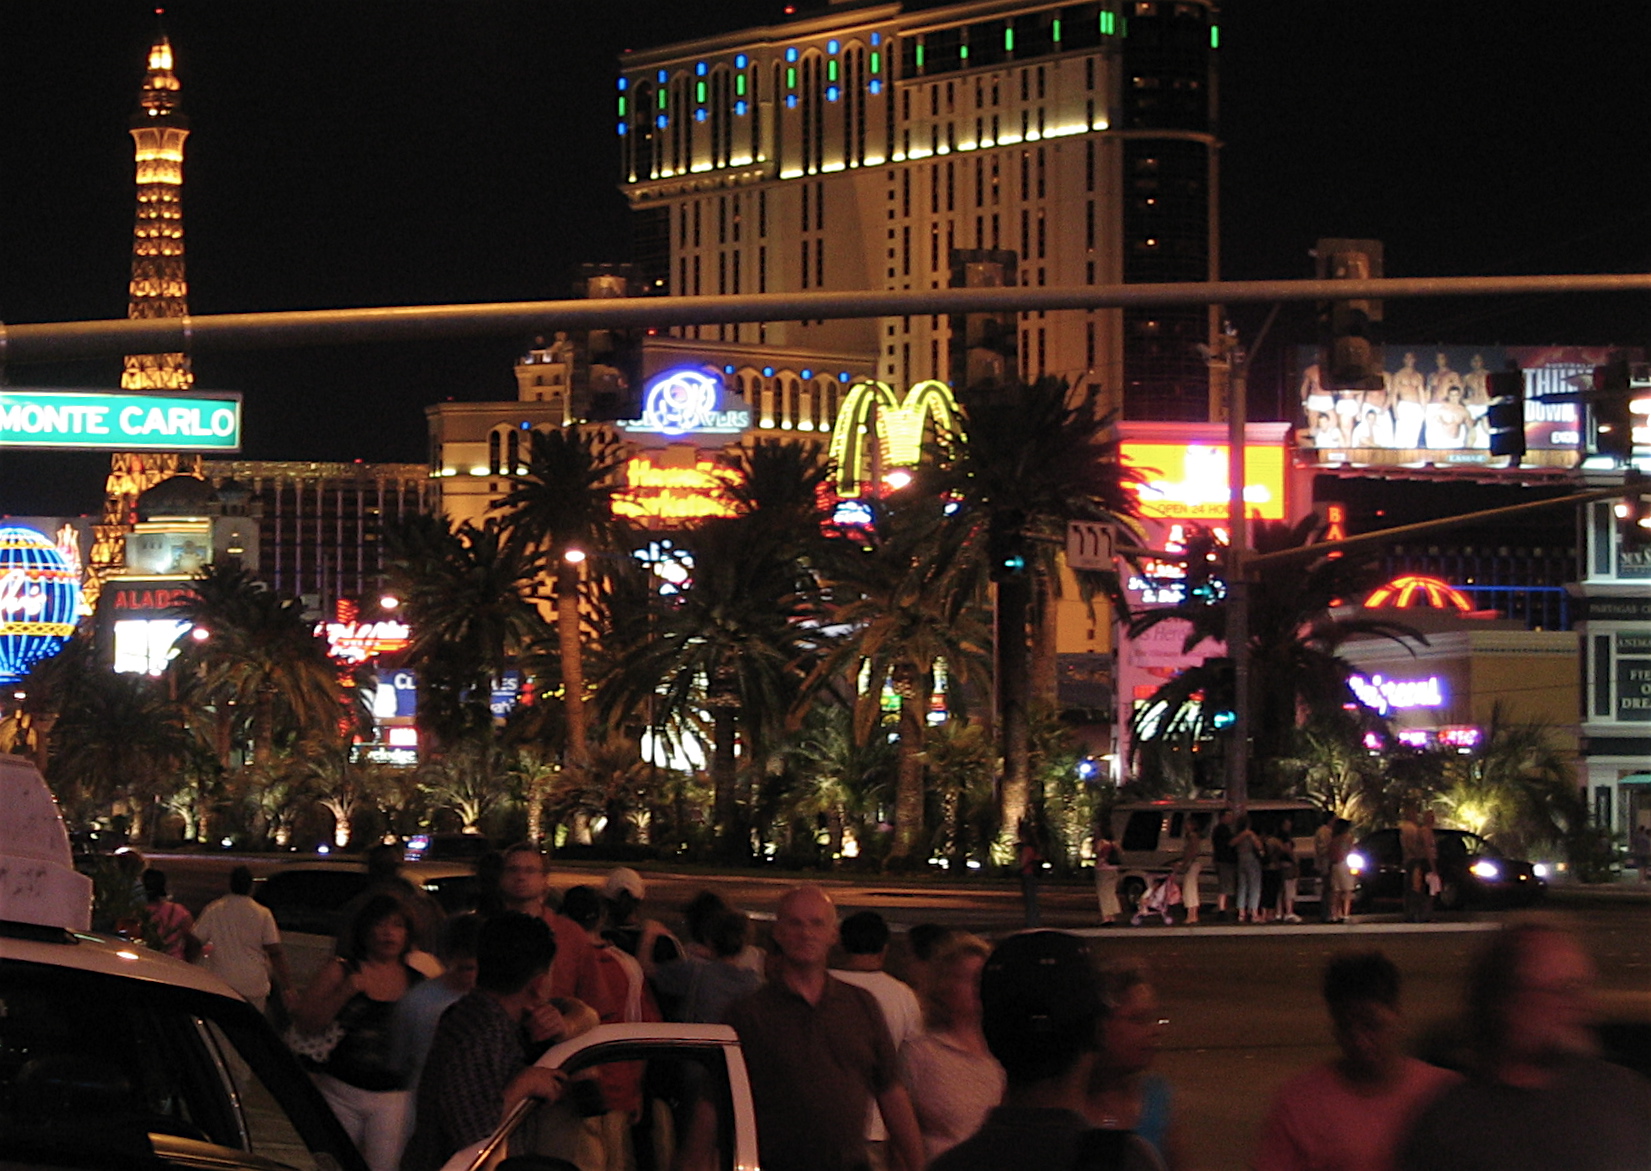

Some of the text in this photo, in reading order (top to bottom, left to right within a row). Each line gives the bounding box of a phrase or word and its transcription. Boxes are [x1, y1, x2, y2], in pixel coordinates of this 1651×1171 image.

[0, 404, 235, 437] MONTE CARLO
[1158, 504, 1187, 514] OPEN
[1191, 504, 1205, 513] 24
[113, 588, 205, 610] ALADD
